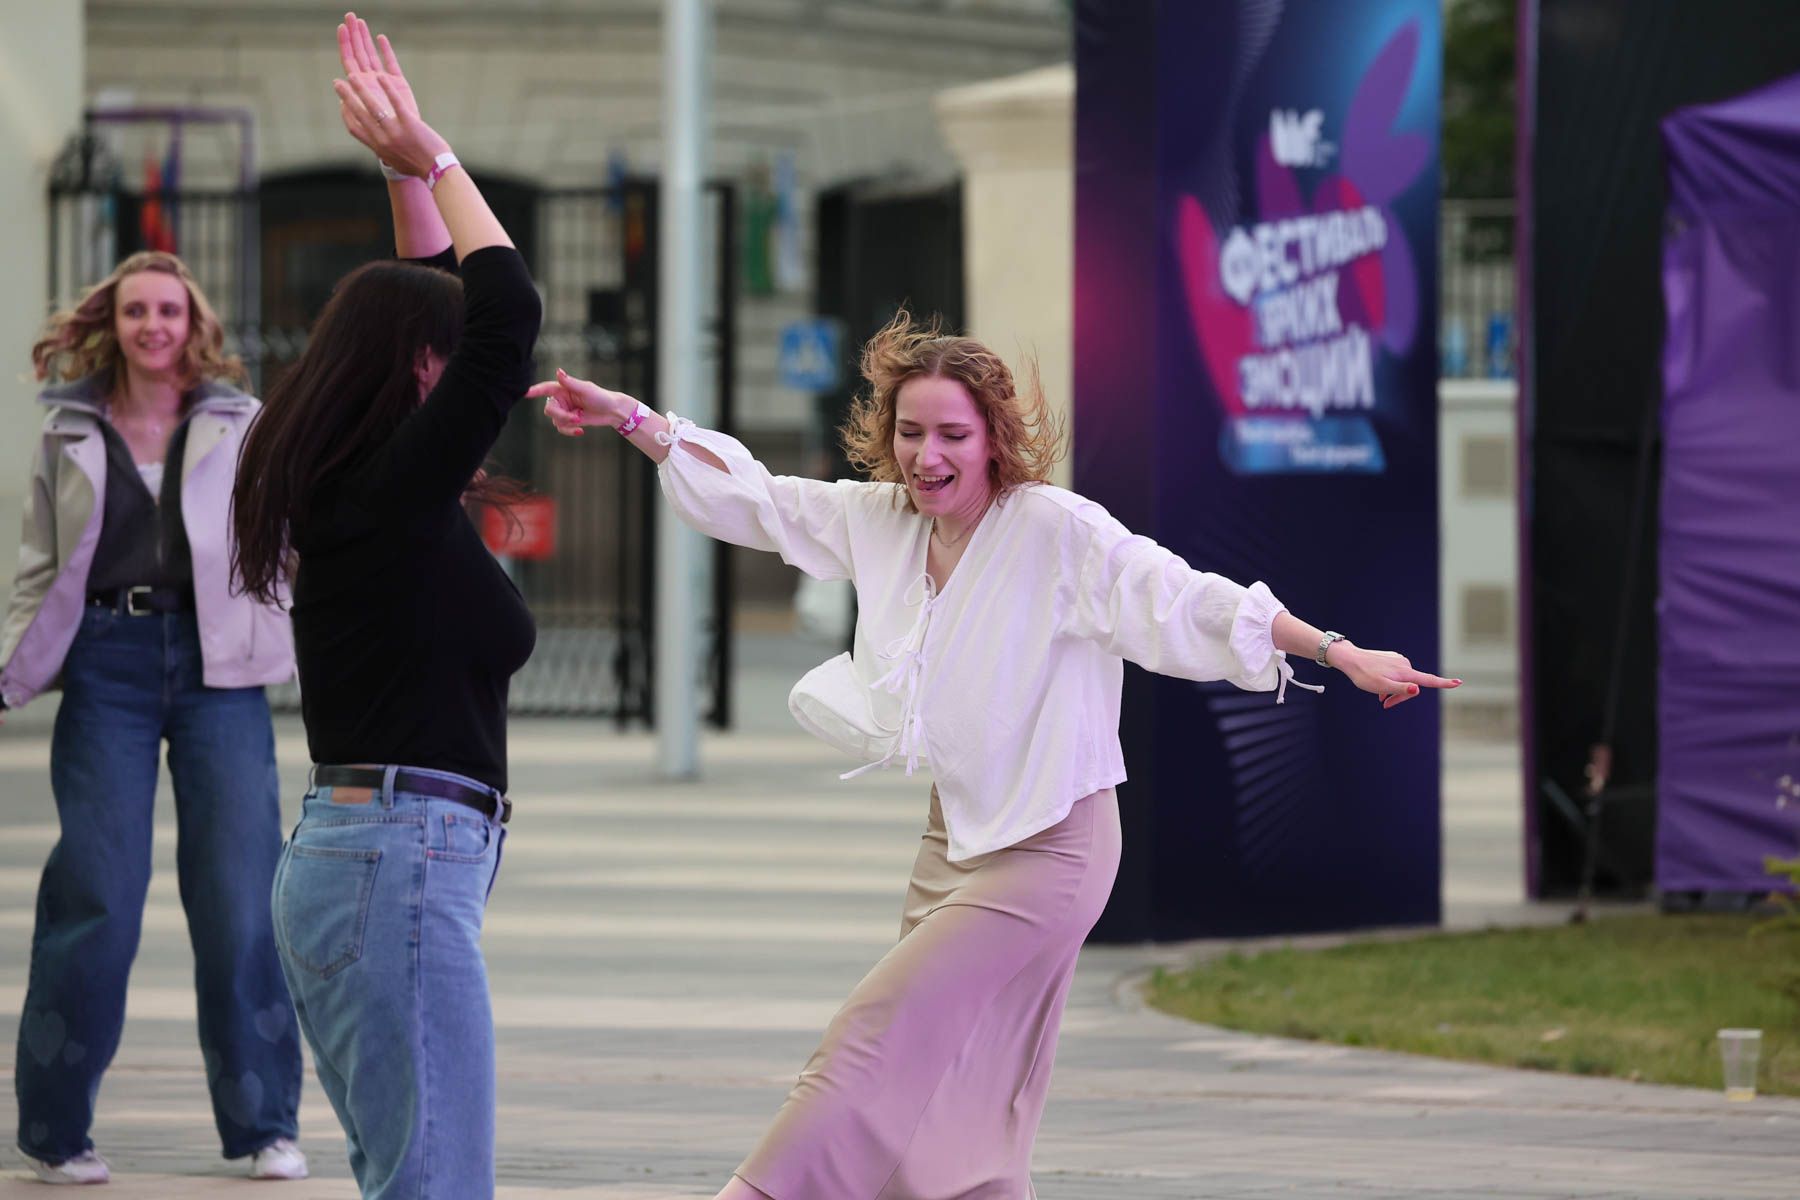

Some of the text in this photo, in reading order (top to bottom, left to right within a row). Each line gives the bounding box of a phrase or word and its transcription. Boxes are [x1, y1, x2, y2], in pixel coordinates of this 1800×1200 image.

[1221, 207, 1388, 304] ФЕСТИВАЛЬ
[1259, 271, 1343, 347] ЯРКИХ
[1239, 323, 1375, 419] ЭМОЦИЙ
